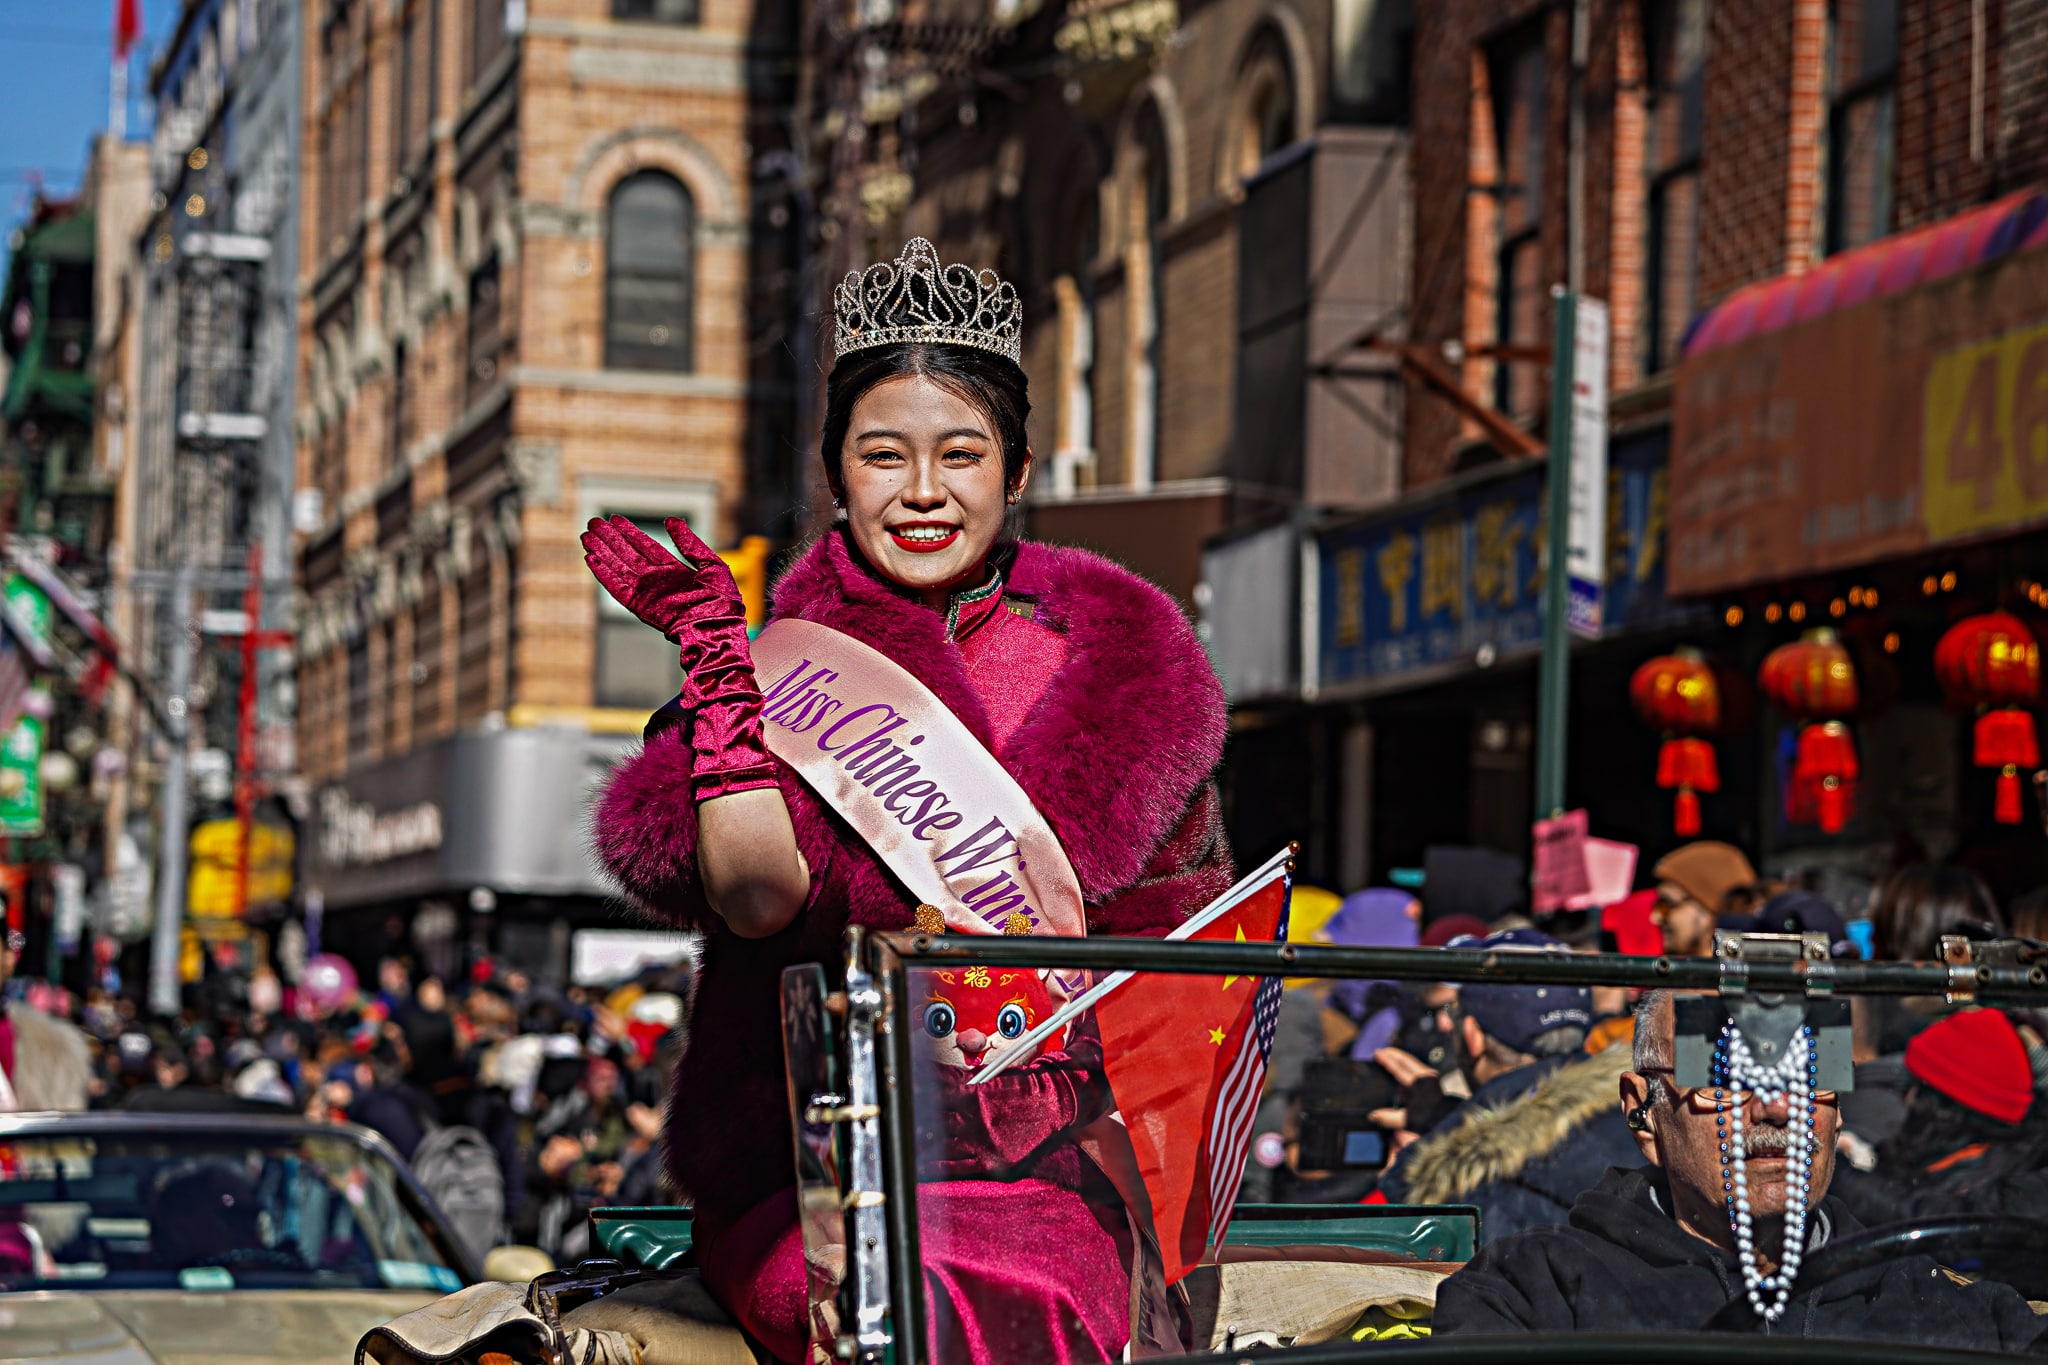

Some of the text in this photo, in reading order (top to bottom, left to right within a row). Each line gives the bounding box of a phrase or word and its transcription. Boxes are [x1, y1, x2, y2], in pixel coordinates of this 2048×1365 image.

[761, 658, 845, 733] Miss
[817, 703, 963, 841] Chinese
[963, 965, 992, 988] 福
[1539, 1009, 1562, 1025] LAS
